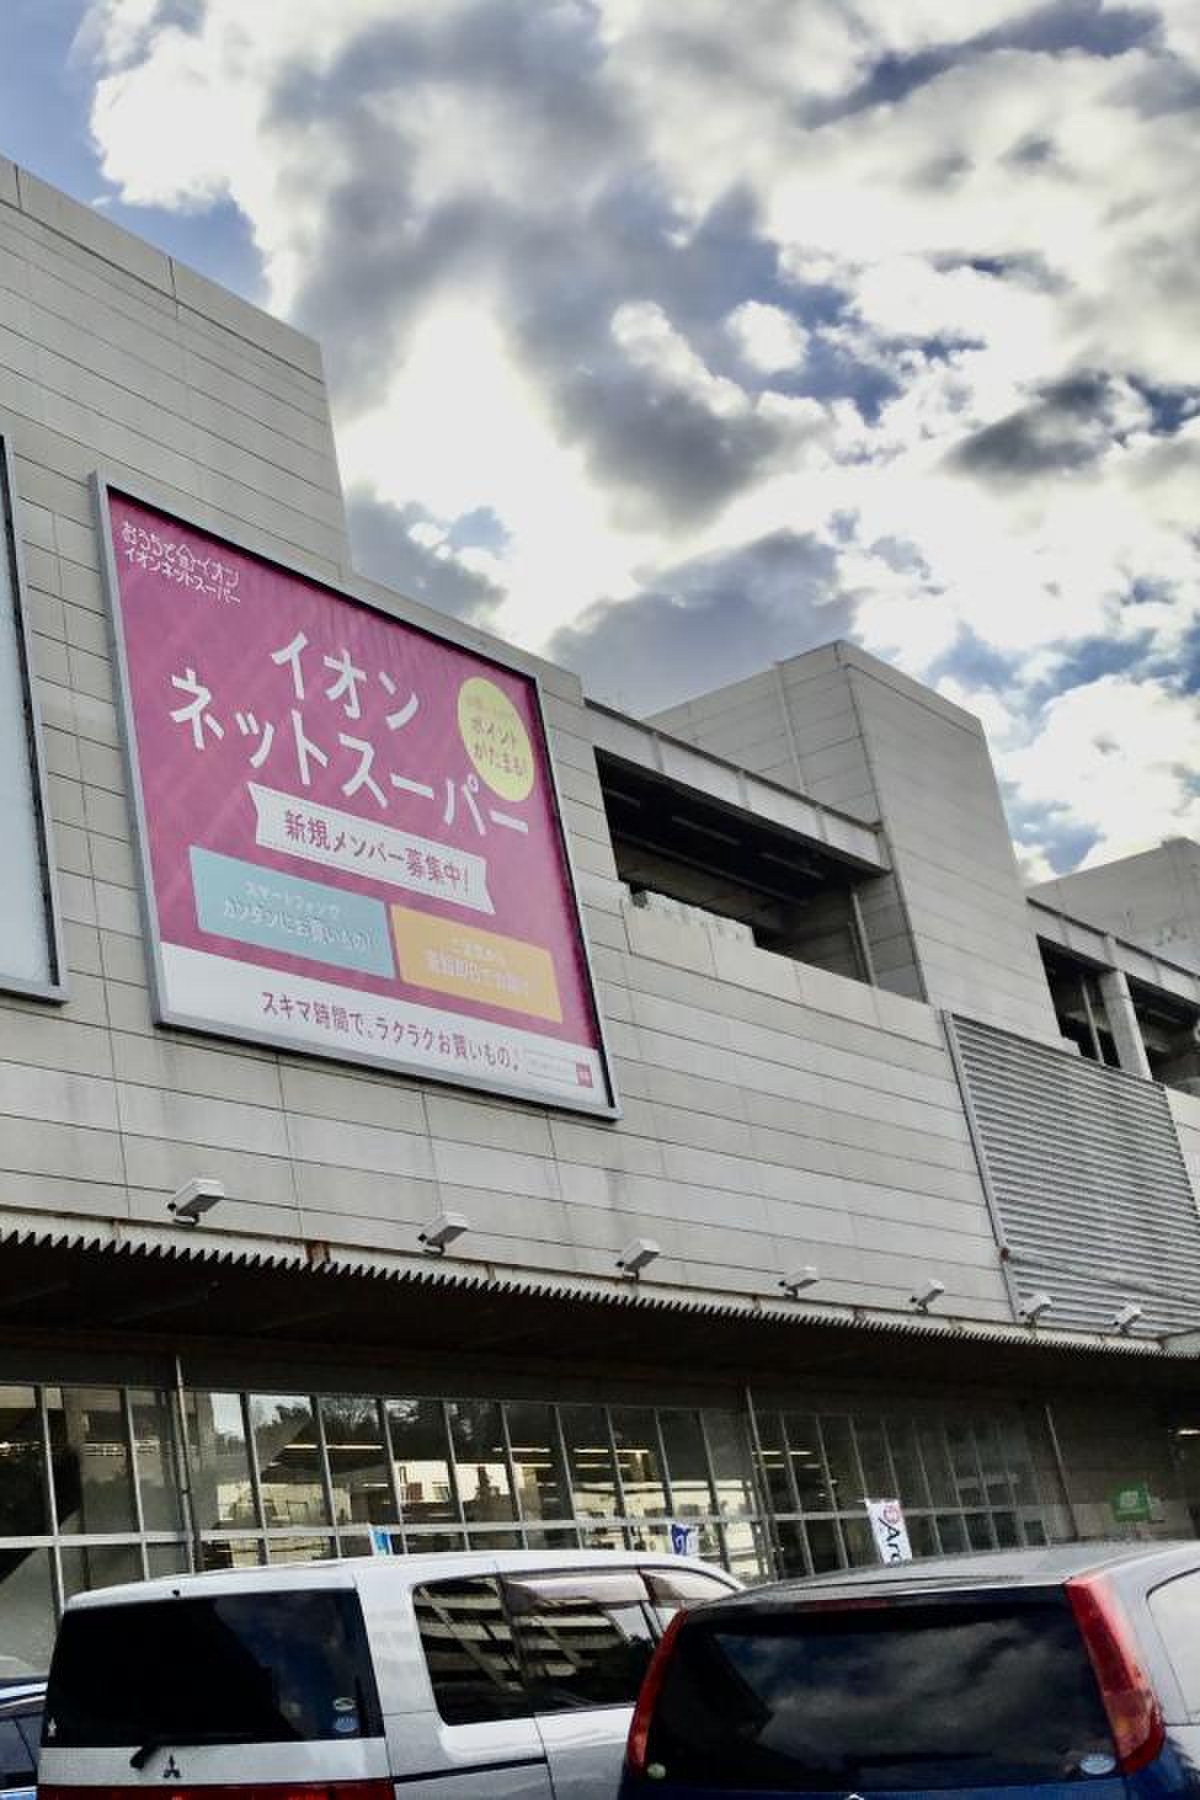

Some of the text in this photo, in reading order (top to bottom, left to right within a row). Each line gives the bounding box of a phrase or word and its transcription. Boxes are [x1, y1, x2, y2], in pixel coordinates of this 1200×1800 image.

[270, 629, 421, 730] イオン
[168, 666, 530, 838] ネットスーパー
[284, 810, 471, 894] 新規メンバー募集中!
